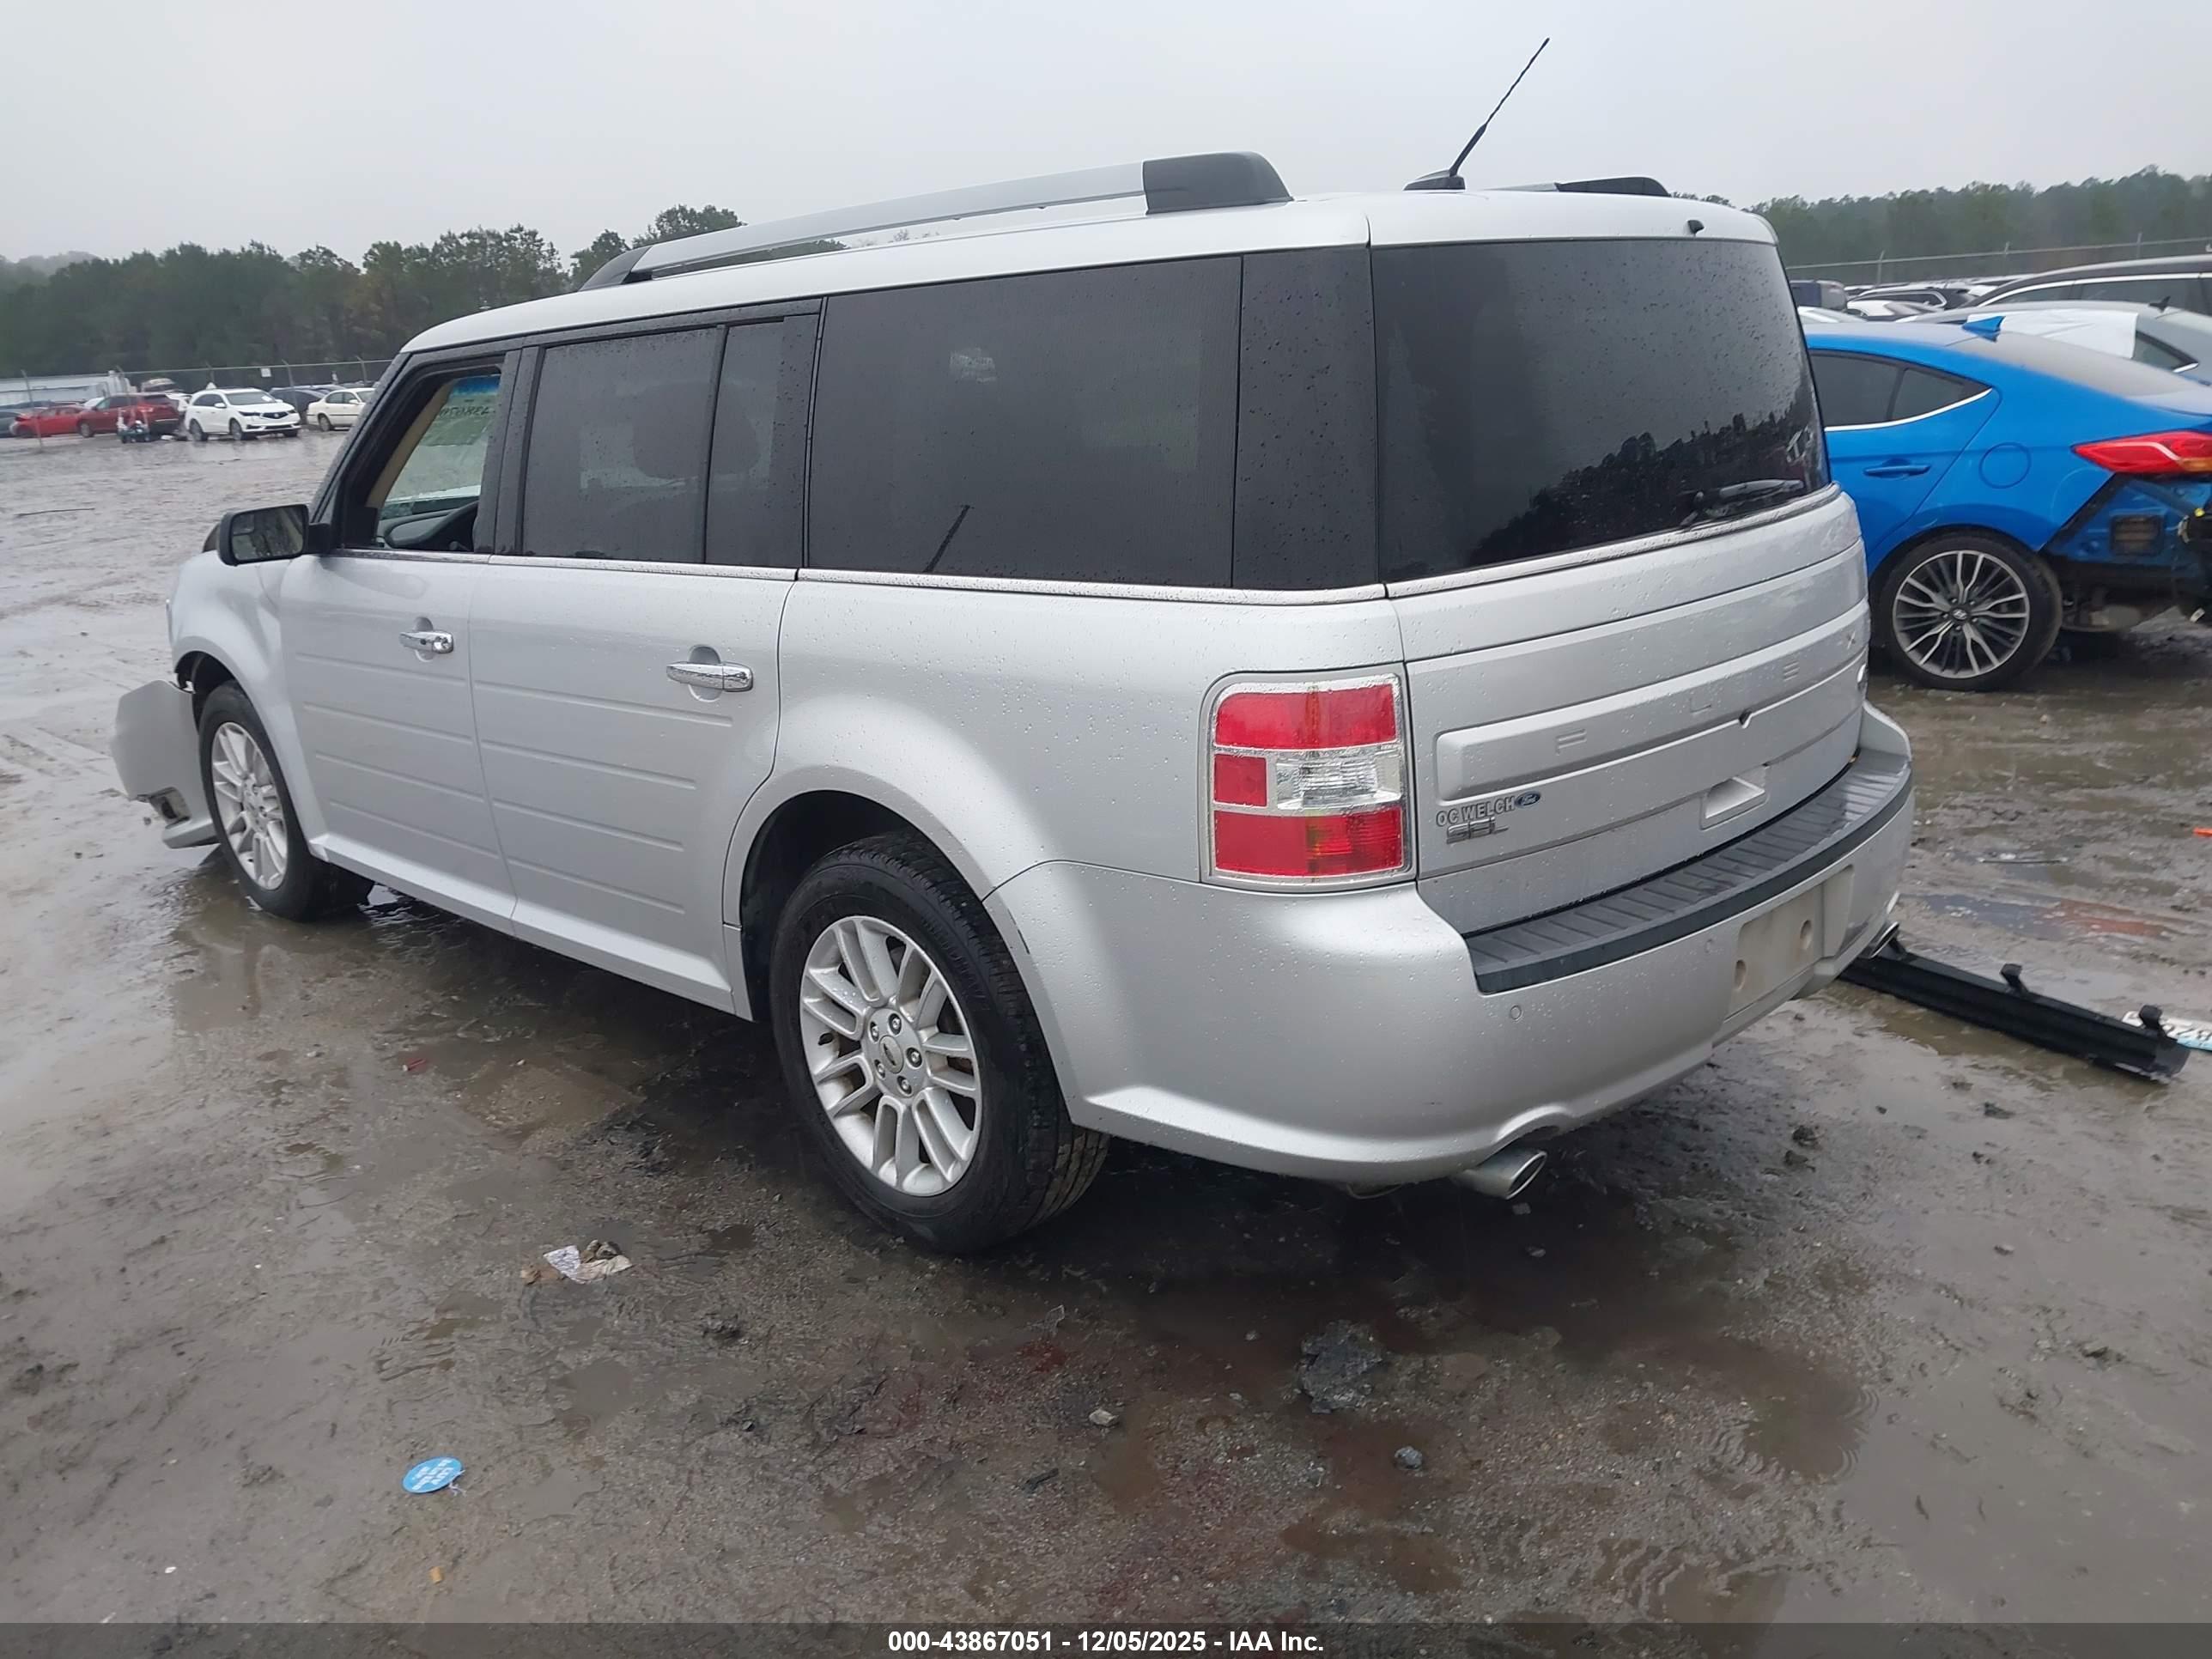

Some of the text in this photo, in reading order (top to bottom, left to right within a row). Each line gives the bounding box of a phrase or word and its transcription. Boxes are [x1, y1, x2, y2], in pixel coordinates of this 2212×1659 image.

[1436, 795, 1516, 827] OC WELCH
[1446, 817, 1509, 845] SEL
